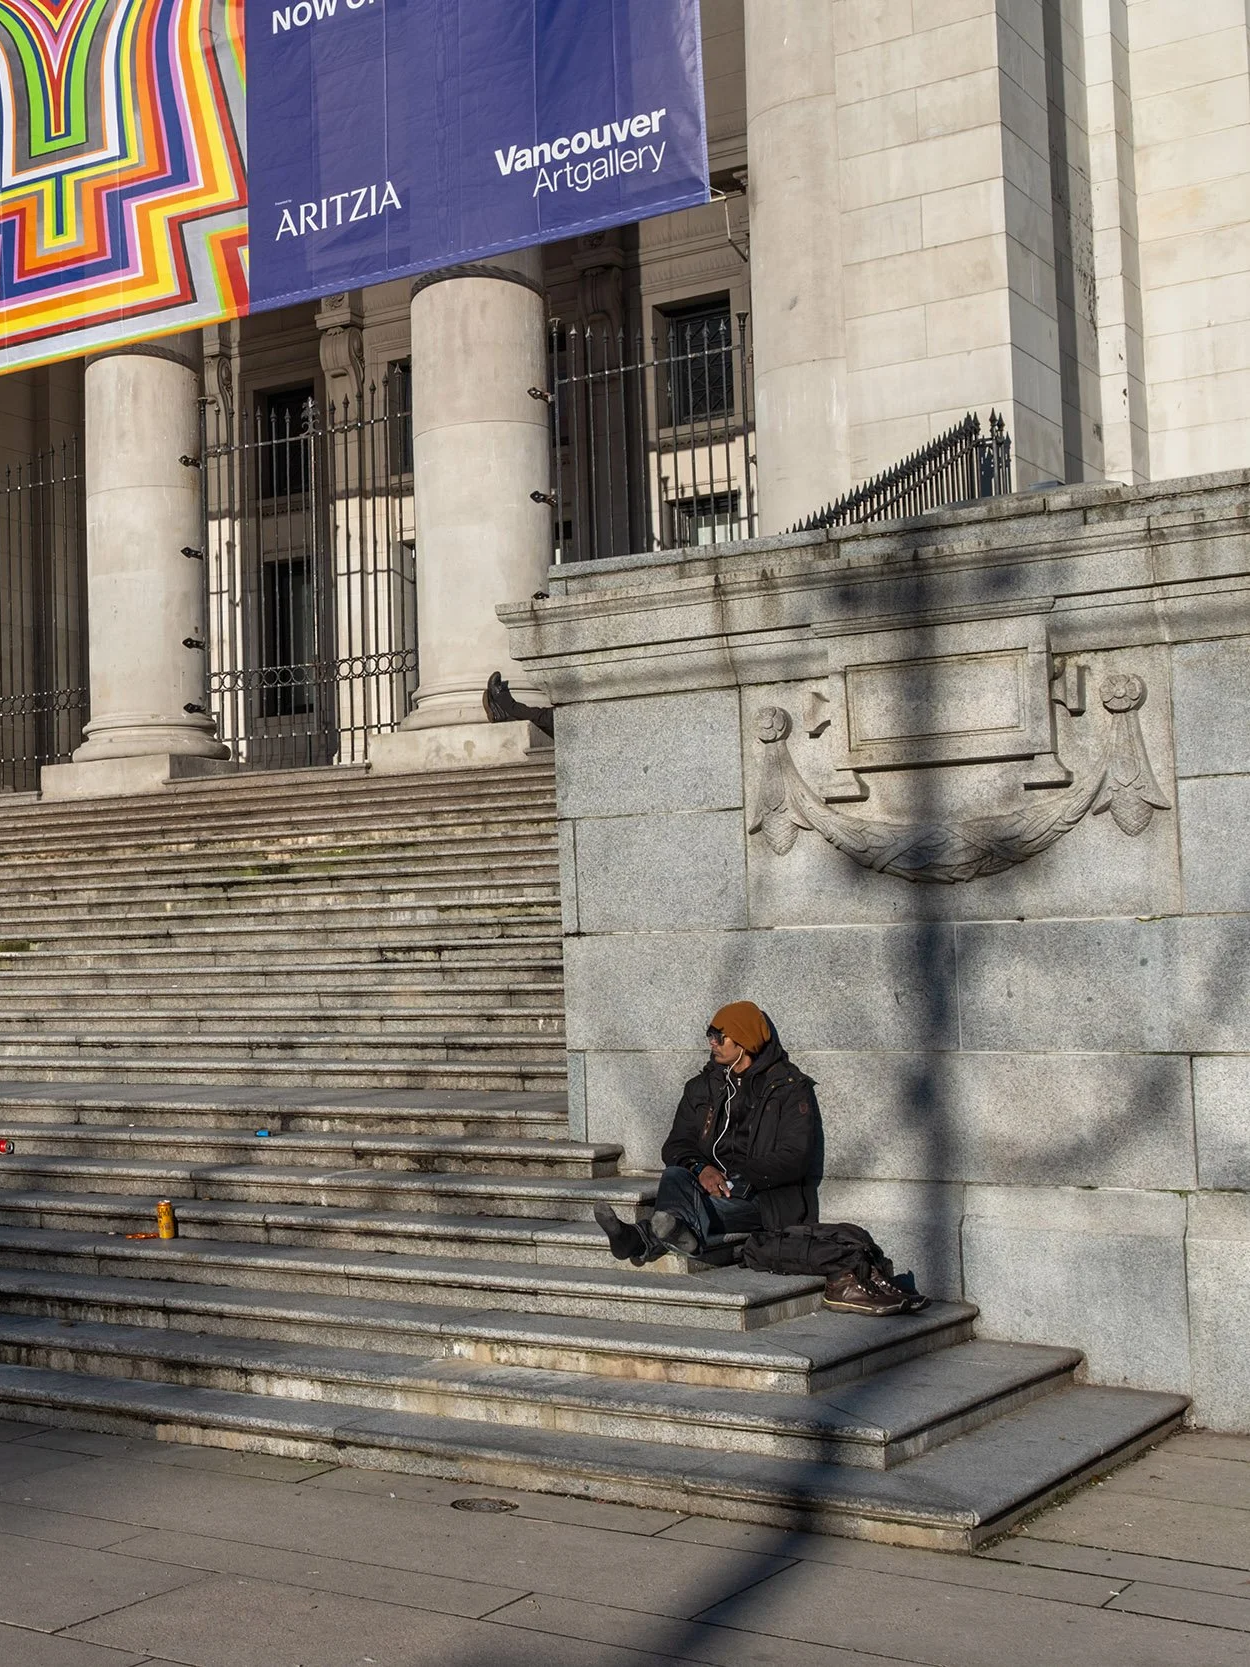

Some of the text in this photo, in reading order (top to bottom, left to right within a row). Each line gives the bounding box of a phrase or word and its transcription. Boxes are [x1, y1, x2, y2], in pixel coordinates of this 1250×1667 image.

[272, 0, 338, 35] NOW
[494, 107, 667, 176] Vancouver
[532, 141, 667, 198] Artgallery
[275, 180, 402, 241] ARITZIA
